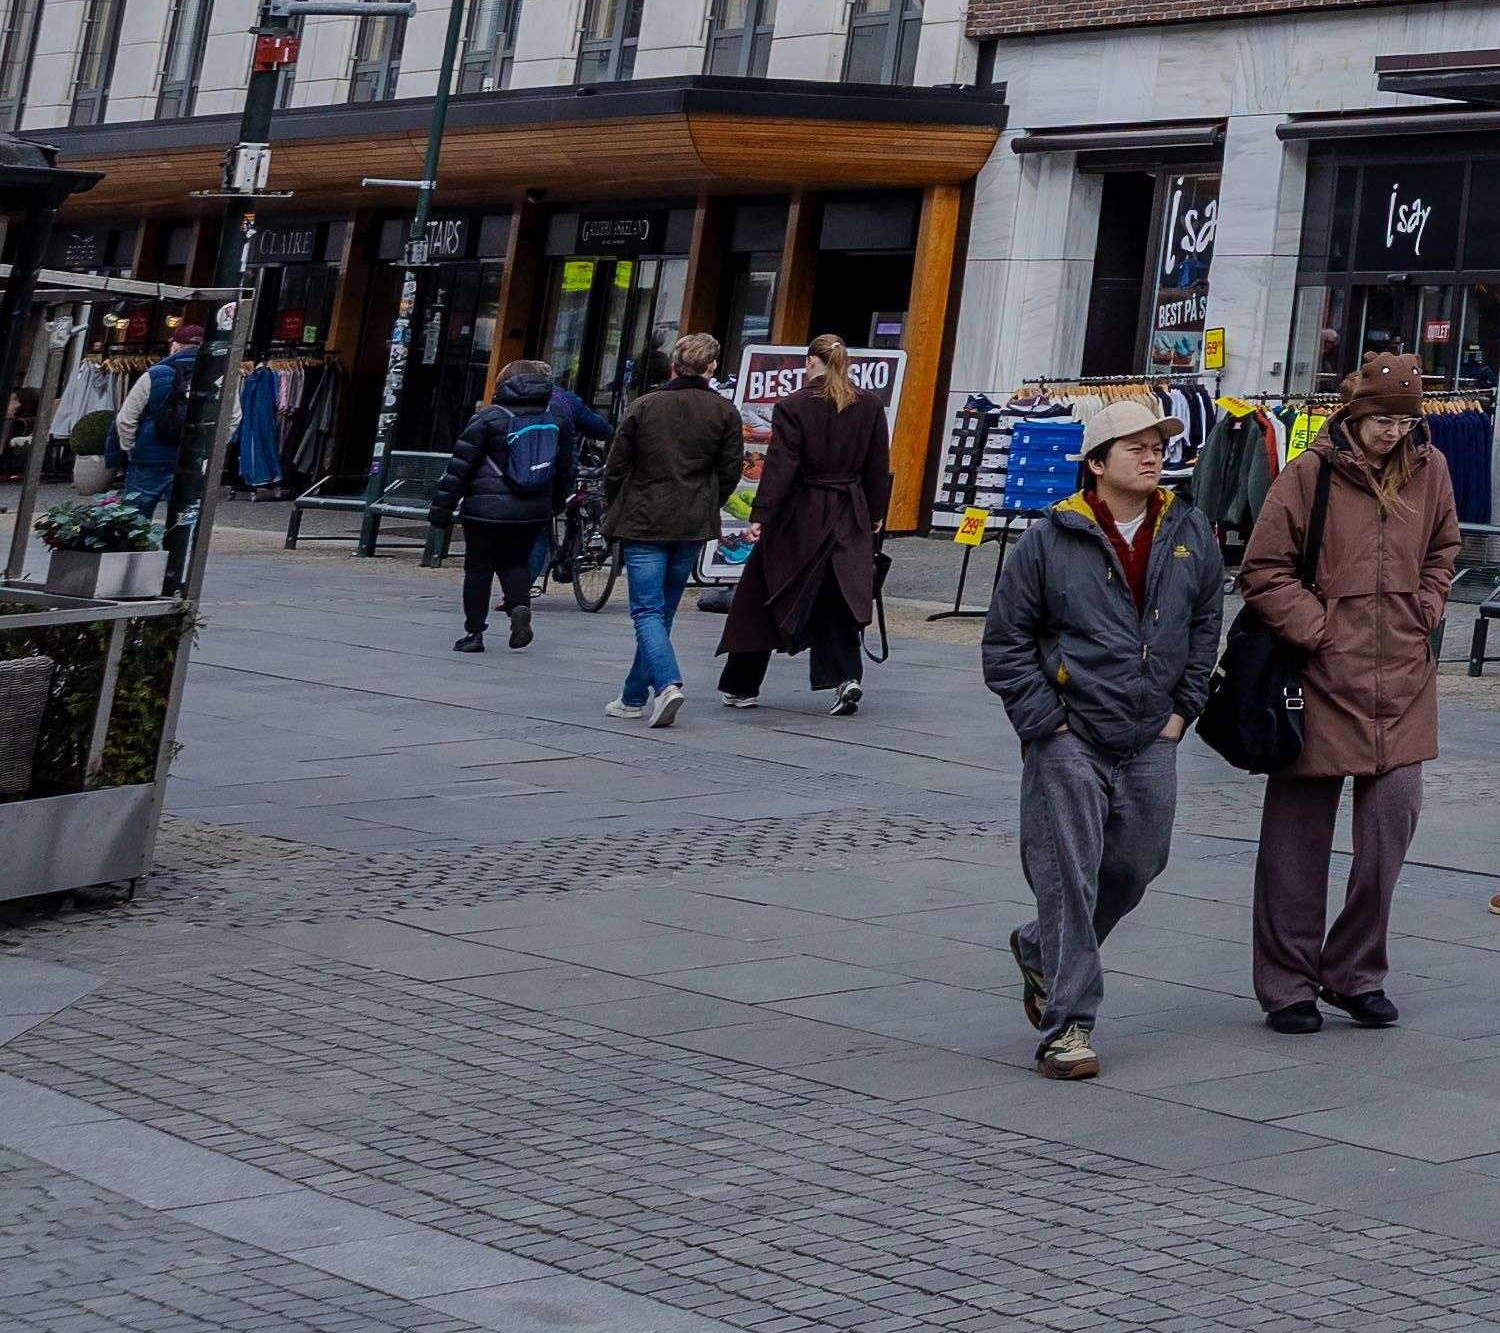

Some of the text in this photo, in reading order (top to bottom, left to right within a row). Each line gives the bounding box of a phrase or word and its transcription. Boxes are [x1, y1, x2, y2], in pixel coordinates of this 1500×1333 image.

[259, 229, 313, 255] CLAIRE
[1158, 301, 1183, 328] BEST
[1184, 292, 1199, 324] PÅ
[750, 360, 889, 400] BEST SKO
